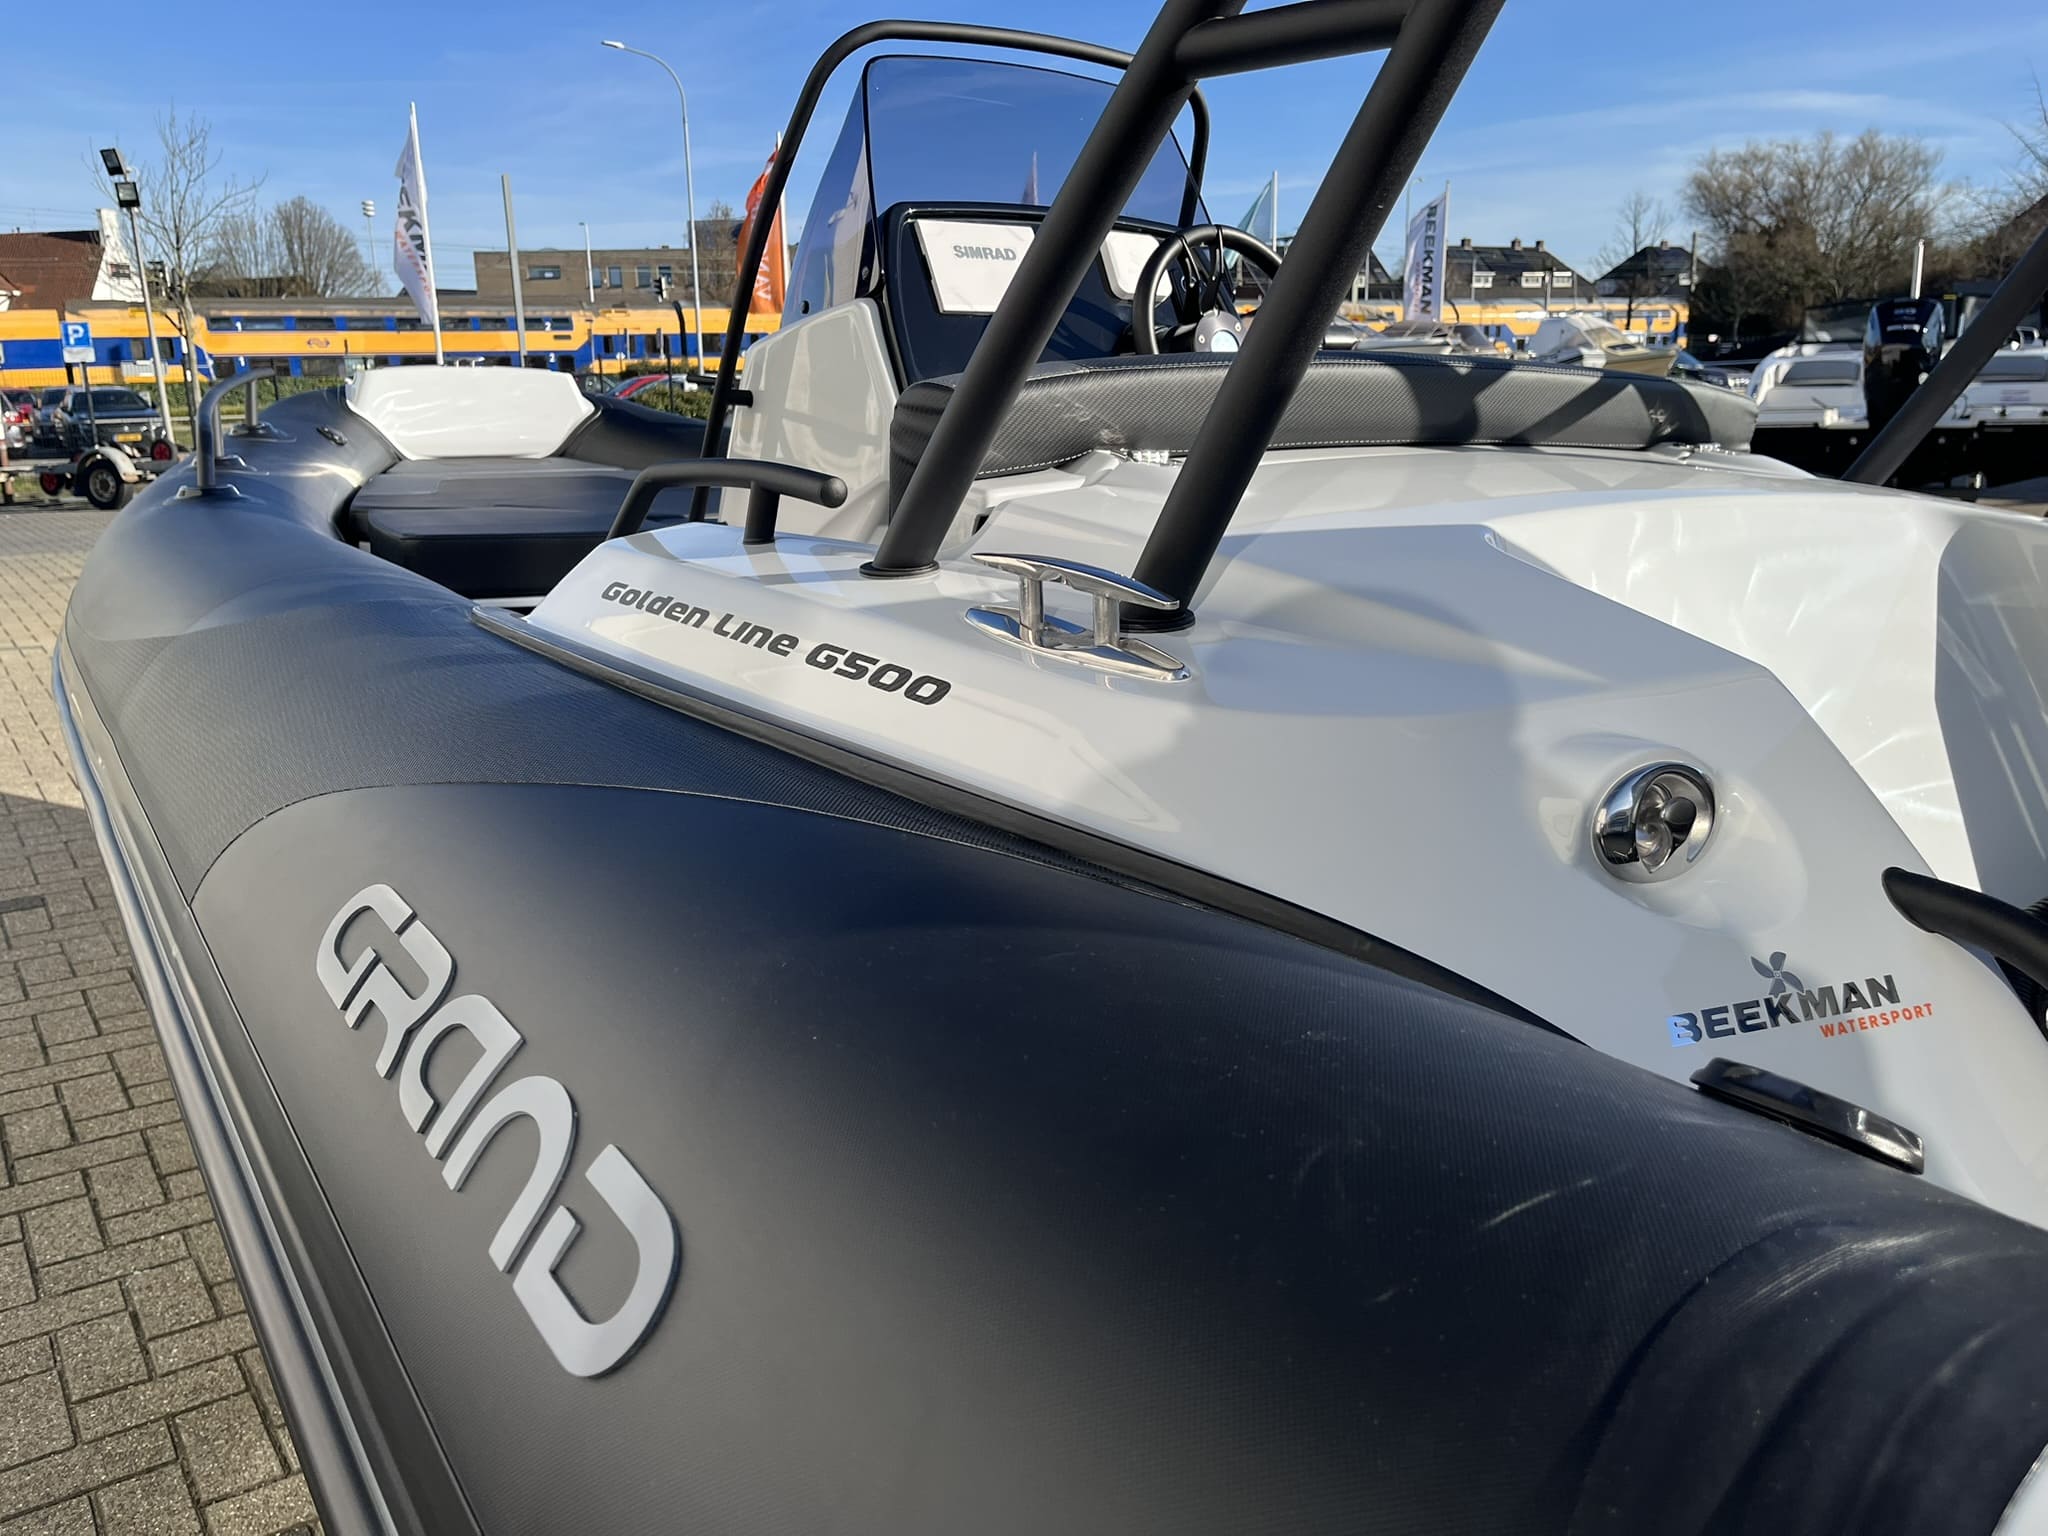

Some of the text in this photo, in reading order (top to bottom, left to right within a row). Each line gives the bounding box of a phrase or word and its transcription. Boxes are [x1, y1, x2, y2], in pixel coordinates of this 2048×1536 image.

[953, 245, 1017, 261] SIMRAD
[1420, 204, 1438, 315] BEEKMAN
[67, 325, 85, 346] P
[601, 581, 710, 628] Golden
[805, 642, 952, 706] G500
[1666, 974, 1901, 1047] BEEKMAN
[1819, 1002, 1934, 1039] WATERSPORT
[316, 883, 679, 1378] GRAND
